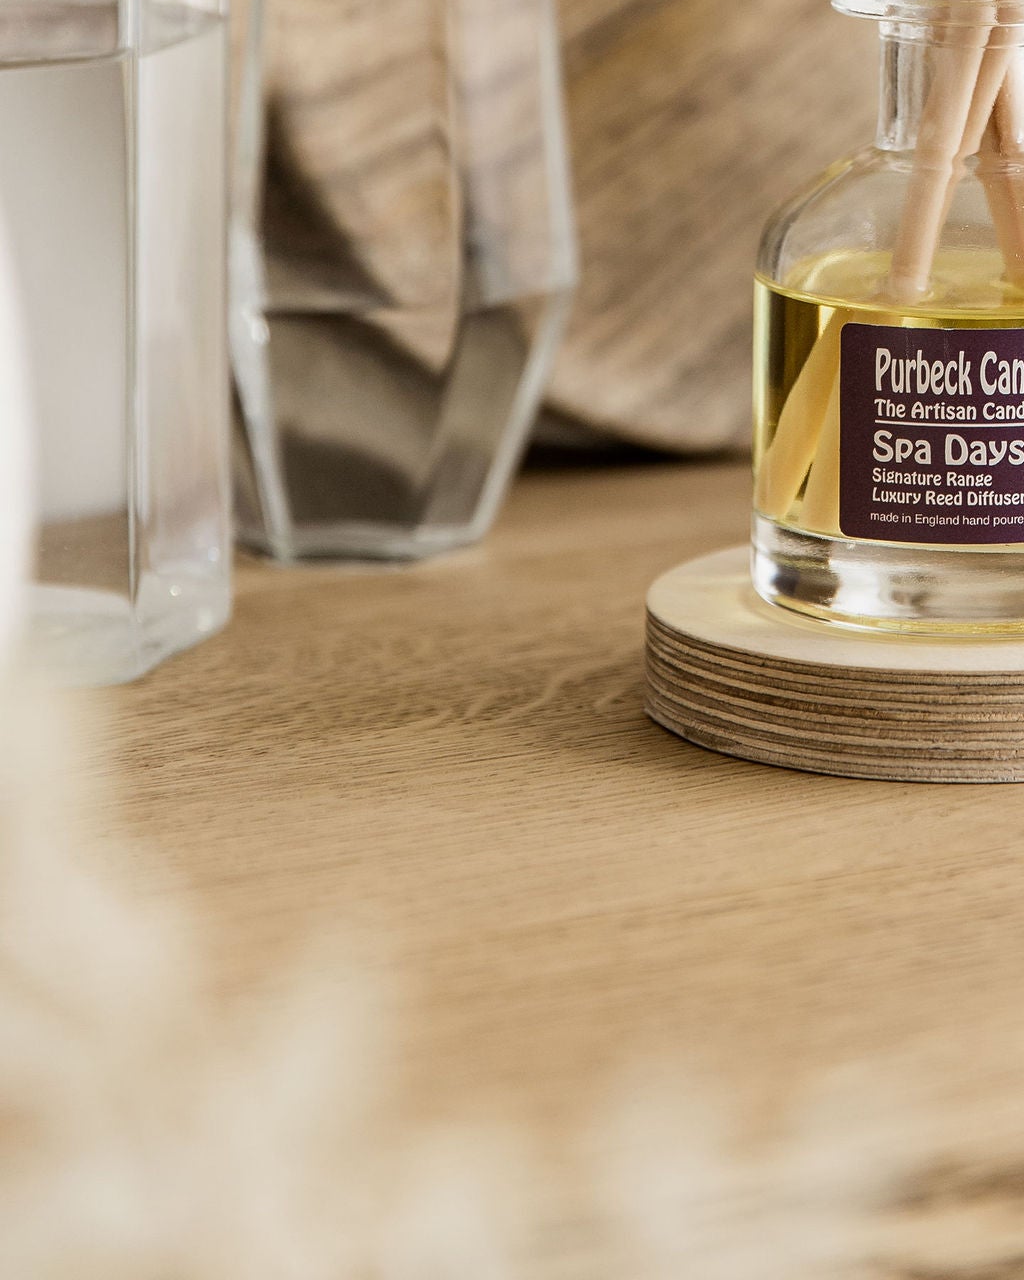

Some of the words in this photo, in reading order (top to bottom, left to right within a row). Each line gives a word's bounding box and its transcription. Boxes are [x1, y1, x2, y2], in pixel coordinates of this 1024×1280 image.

[875, 347, 973, 396] Purbeck
[874, 399, 906, 418] The
[911, 401, 977, 420] Artisan
[872, 429, 932, 465] Spa
[872, 467, 942, 487] Signature
[946, 471, 993, 487] Range
[872, 487, 921, 505] Luxury
[925, 490, 963, 506] Reed
[870, 511, 899, 523] made
[902, 512, 912, 523] in
[915, 513, 960, 527] England
[962, 514, 990, 525] hand
